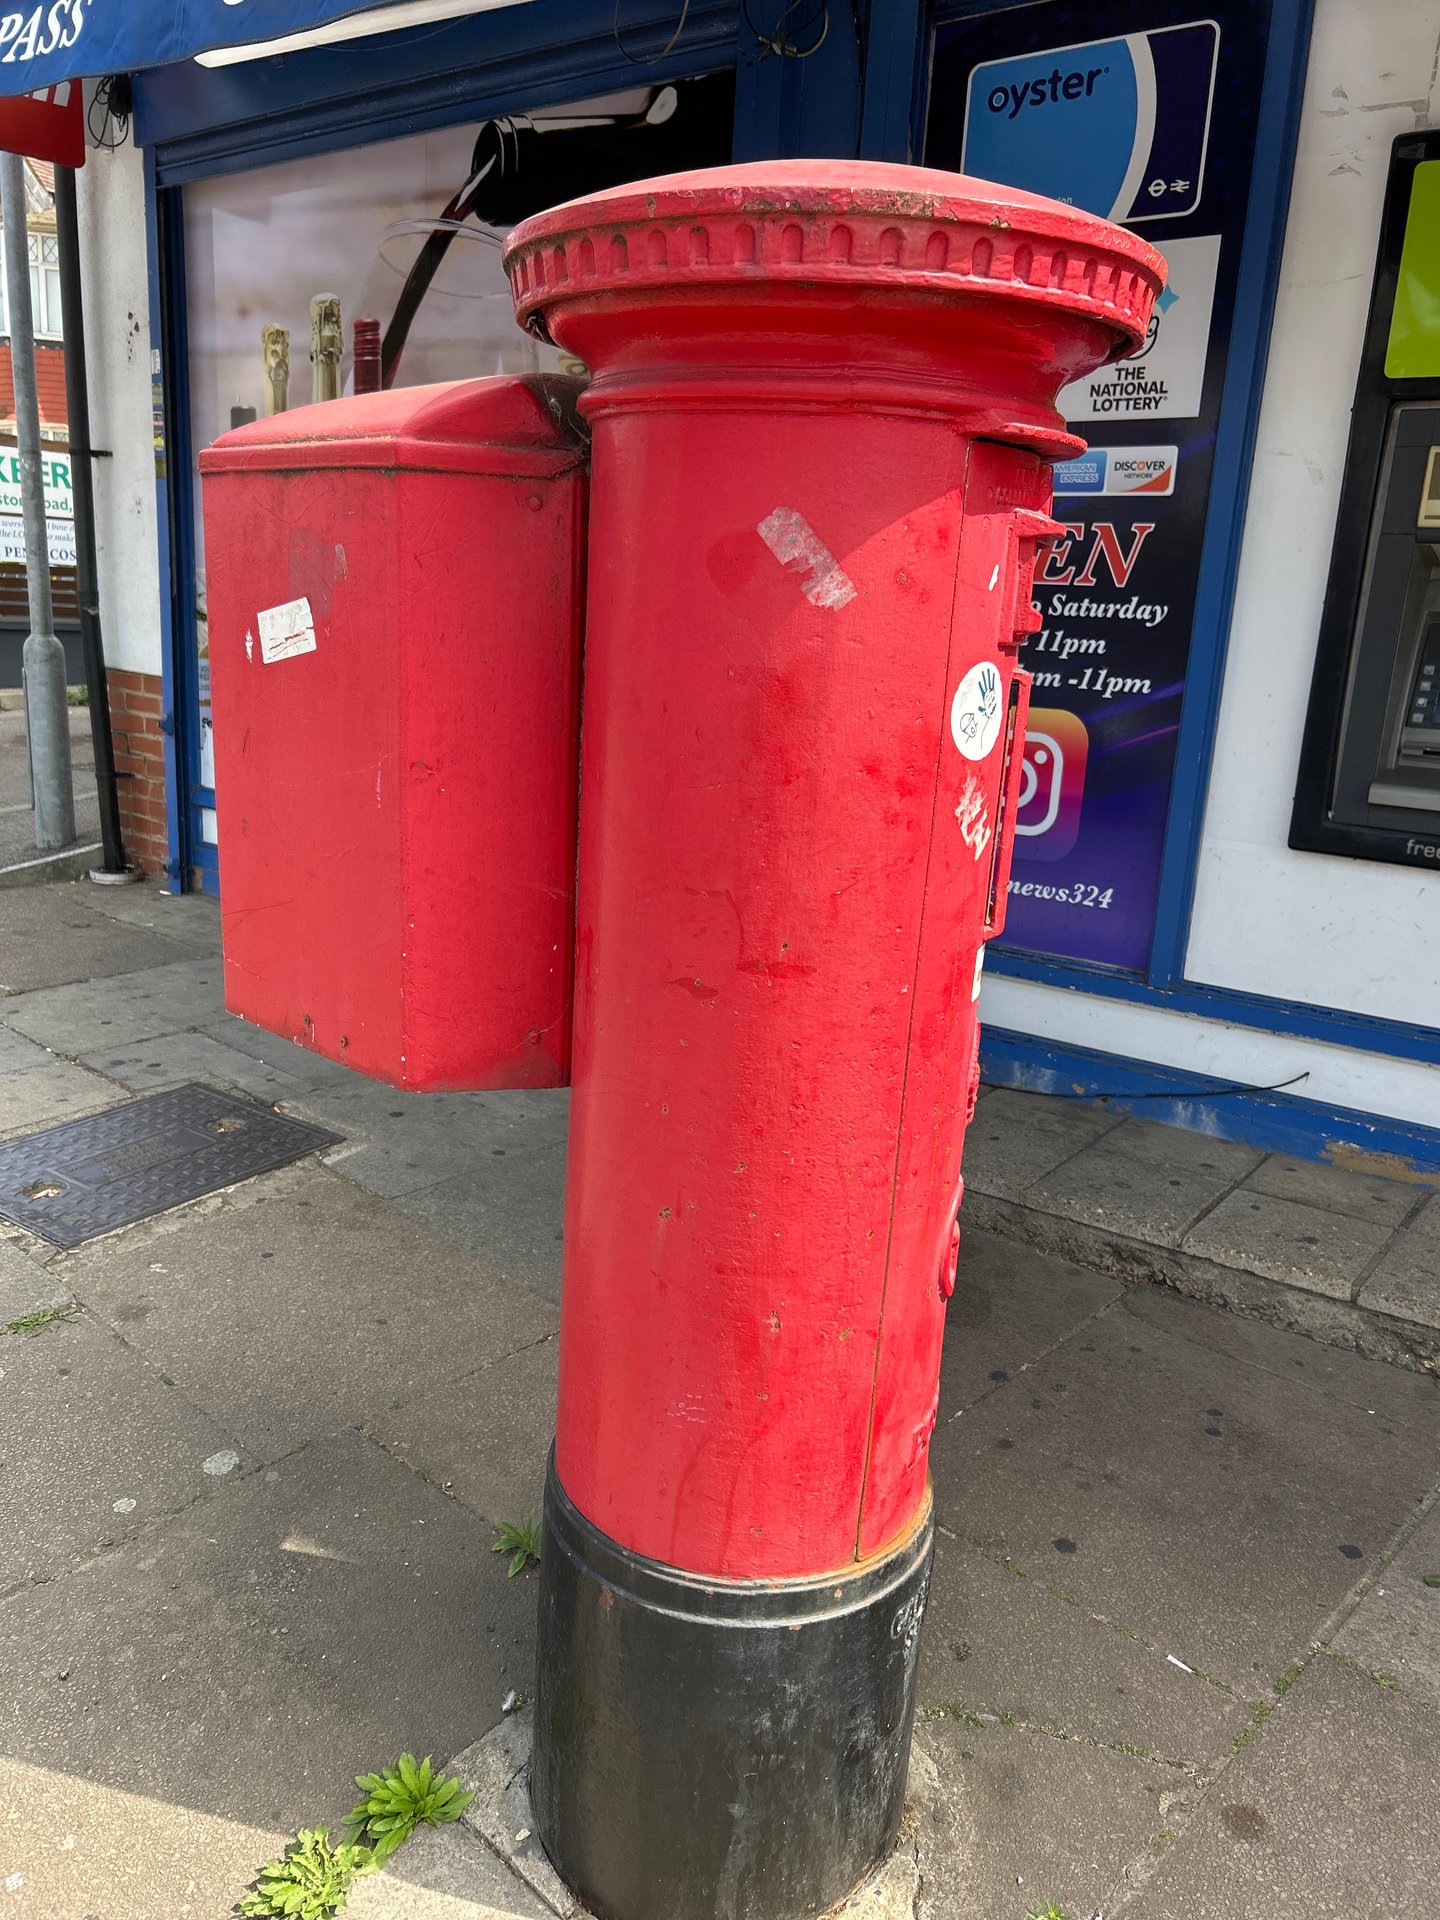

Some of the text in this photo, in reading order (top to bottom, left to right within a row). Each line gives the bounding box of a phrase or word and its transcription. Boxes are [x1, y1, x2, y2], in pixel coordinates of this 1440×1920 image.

[988, 69, 1102, 120] oyster
[1115, 367, 1146, 381] THE
[1089, 381, 1168, 398] NATIONAL
[1092, 396, 1163, 412] LOTTERY
[1054, 463, 1097, 473] AMERICAN
[1114, 461, 1165, 471] DISCOVER
[1060, 473, 1099, 483] EXPRESS
[1048, 593, 1168, 627] Saturday
[1035, 629, 1106, 660] 11pm
[1007, 880, 1114, 909] news324
